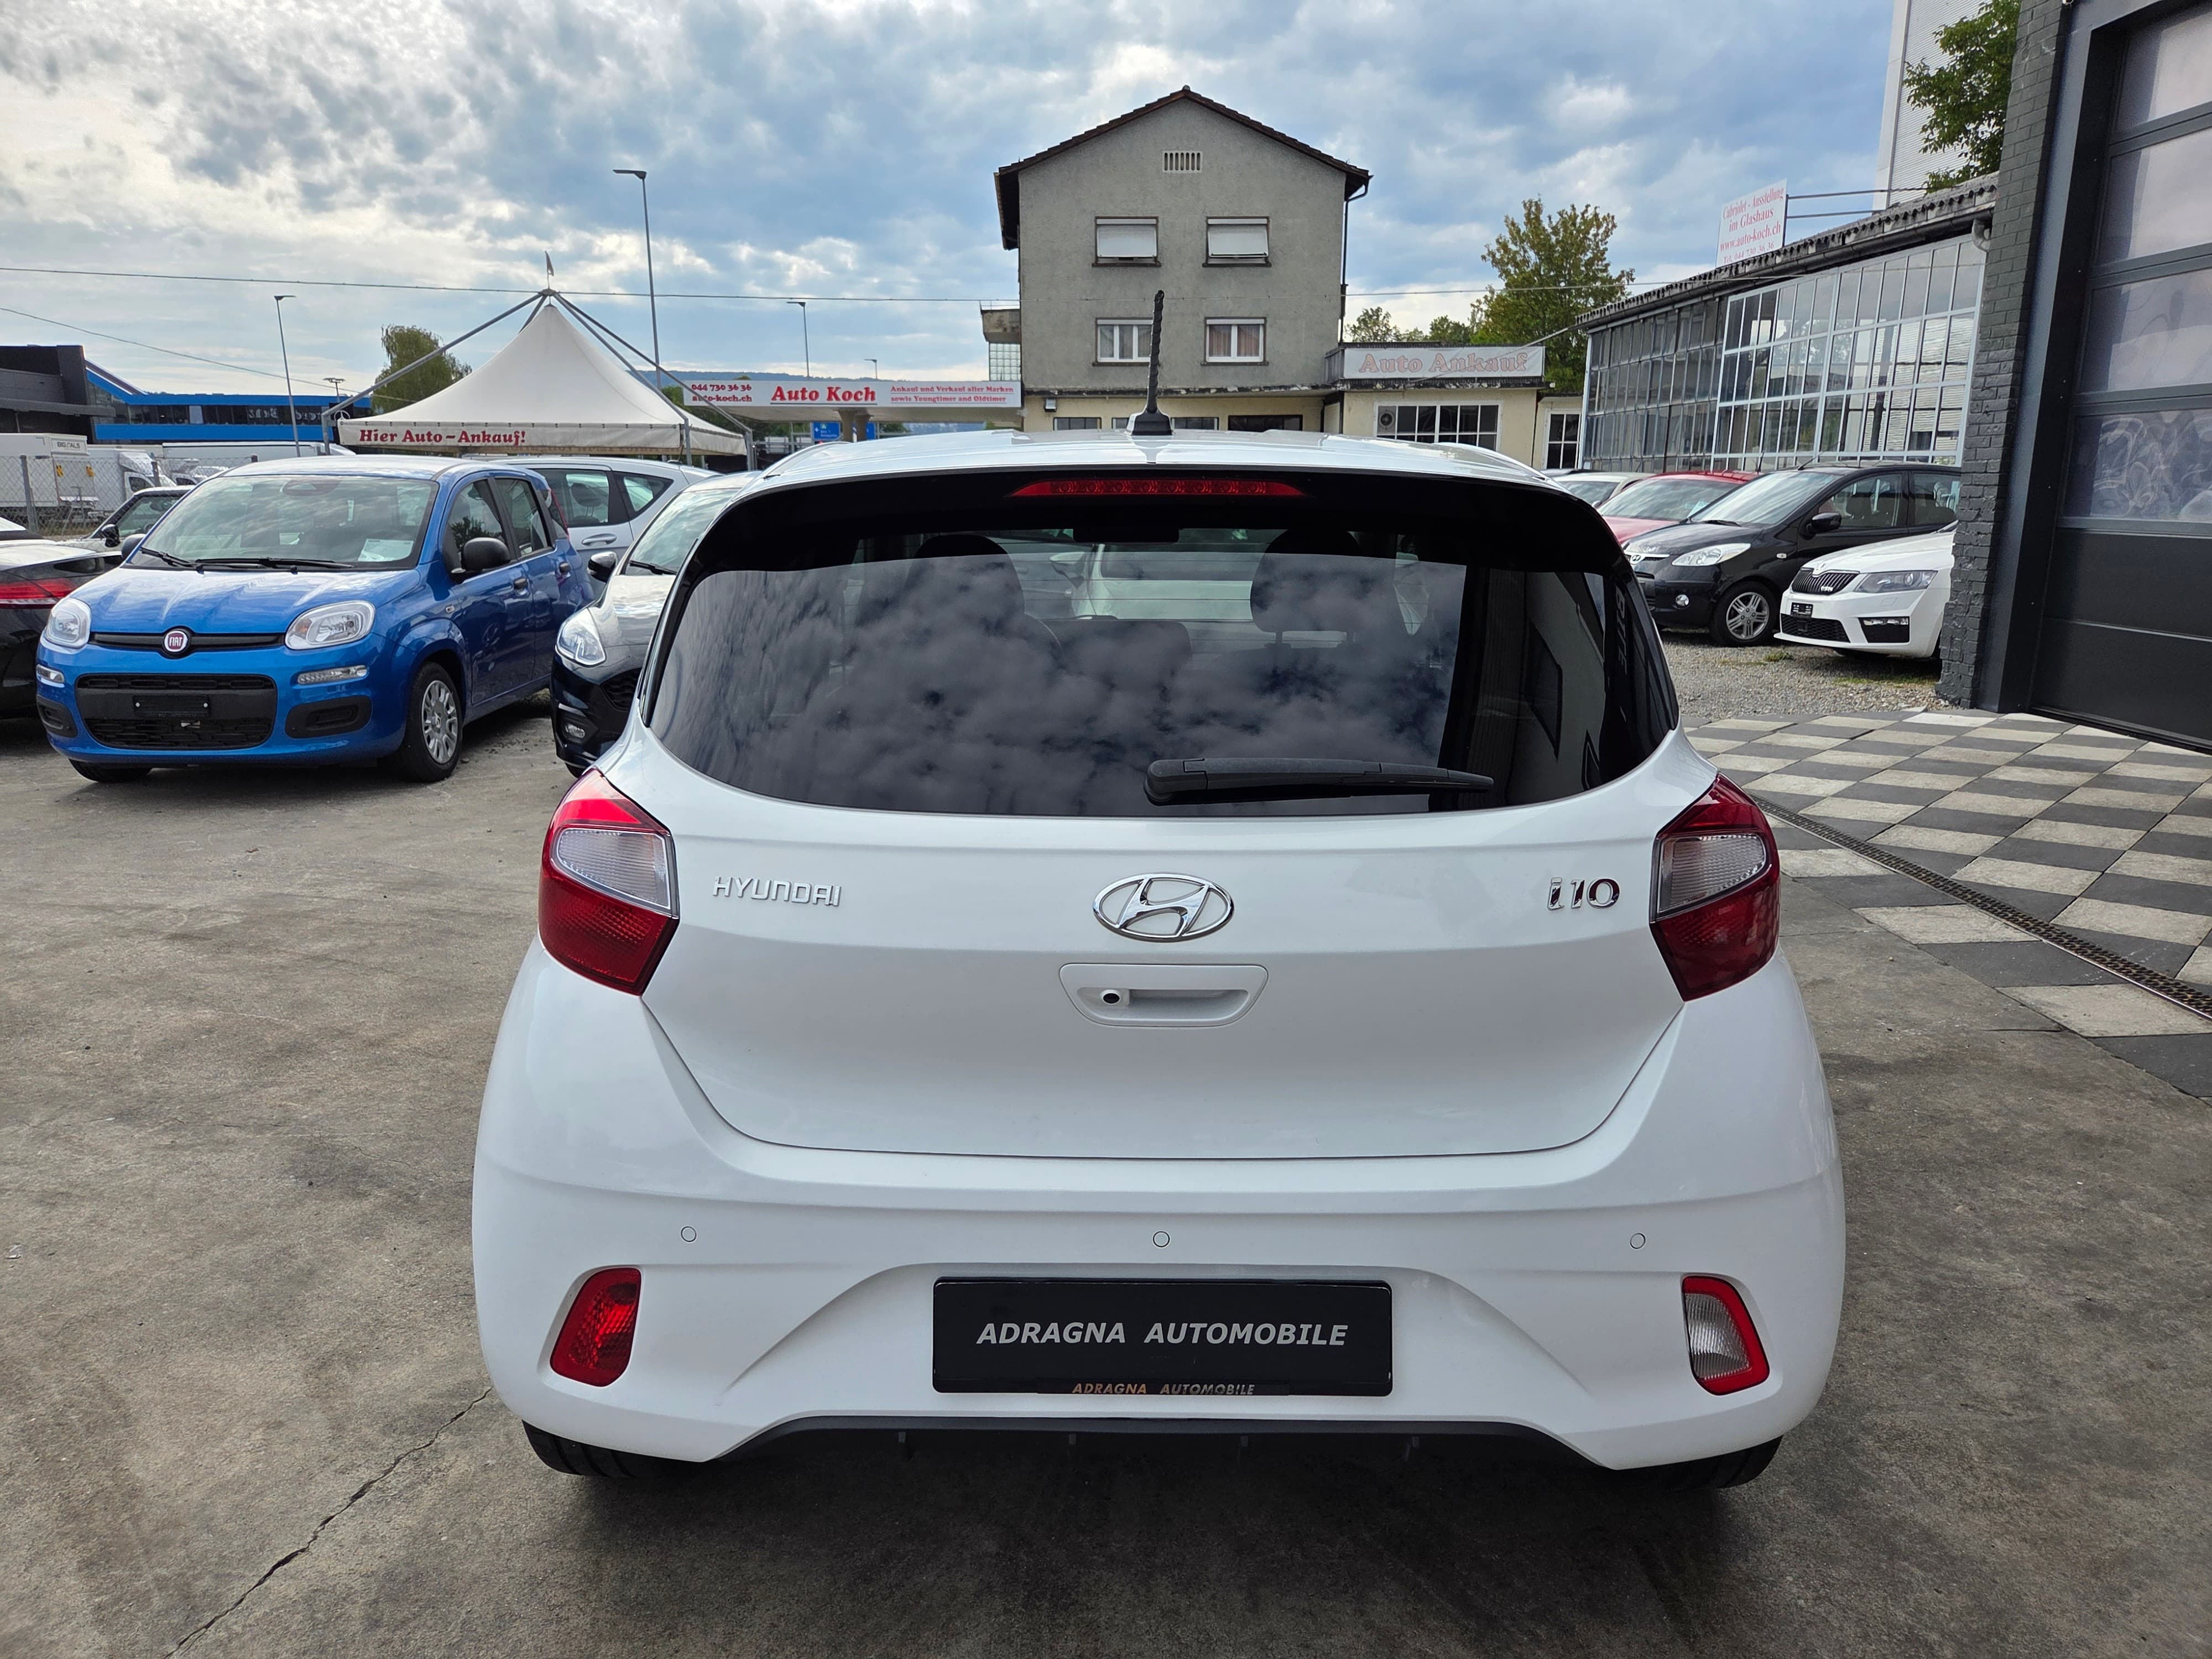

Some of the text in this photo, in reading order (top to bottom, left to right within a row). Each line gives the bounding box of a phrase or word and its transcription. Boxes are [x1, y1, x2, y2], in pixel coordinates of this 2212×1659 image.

[1729, 208, 1774, 232] im Glashaus
[1720, 221, 1781, 252] www.auto-koch.ch
[1359, 352, 1528, 373] Auto Ankauf
[771, 385, 876, 402] Auto Koch
[360, 430, 398, 442] Hier
[169, 637, 182, 646] FIAT
[712, 876, 842, 907] HYUNDAI
[1547, 877, 1620, 910] i10
[976, 1322, 1348, 1346] ADRAGNA AUTOMOBILE
[1072, 1383, 1255, 1395] ADRAGNA AUTOMOBILE
